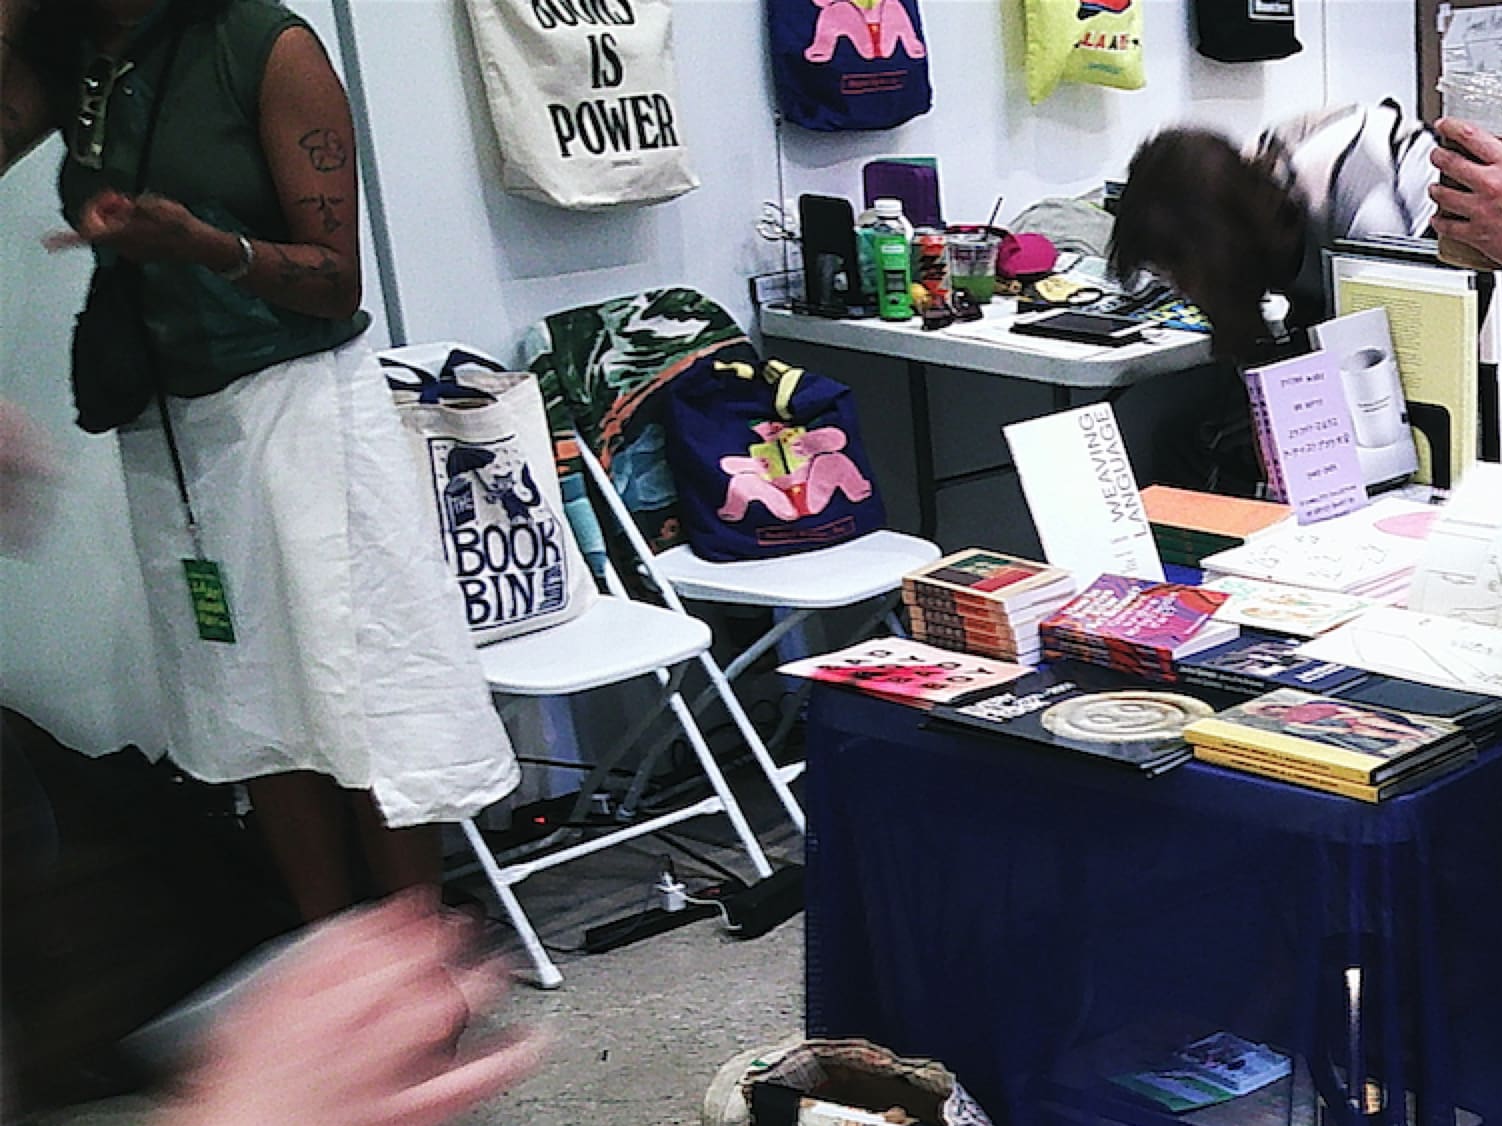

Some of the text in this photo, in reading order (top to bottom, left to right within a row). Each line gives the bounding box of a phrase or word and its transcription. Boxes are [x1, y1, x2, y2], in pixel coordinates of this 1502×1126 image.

[587, 32, 624, 89] IS
[547, 93, 680, 158] POWER
[1078, 413, 1125, 523] WEAVING
[1094, 409, 1148, 538] LANGUAGE
[452, 521, 562, 577] BOOK
[459, 571, 536, 625] BIN
